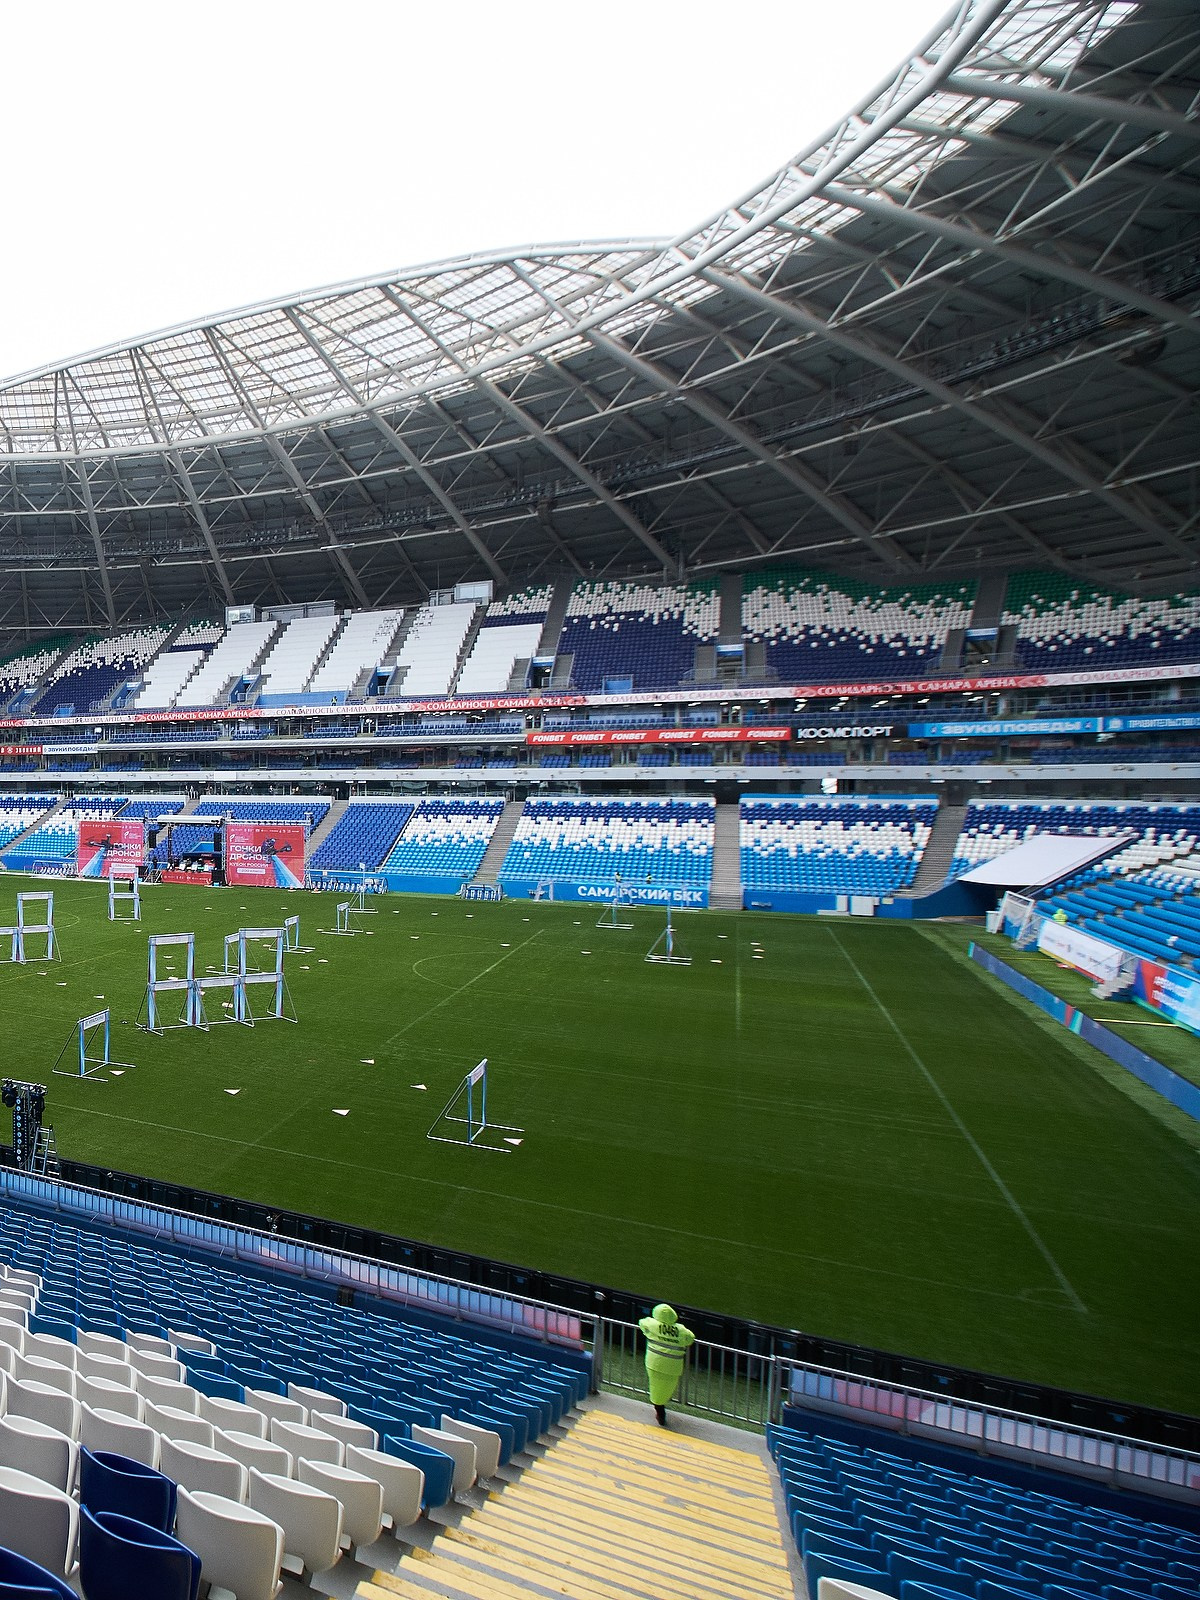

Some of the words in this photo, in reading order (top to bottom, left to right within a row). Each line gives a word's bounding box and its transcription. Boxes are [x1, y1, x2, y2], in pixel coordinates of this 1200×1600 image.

[917, 681, 973, 692] САМАРА
[974, 678, 1018, 688] АРЕНА
[336, 706, 368, 714] САМАРА
[369, 705, 395, 713] АРЕНА
[426, 701, 495, 710] СОЛИДАРНОСТЬ
[497, 699, 535, 708] САМАРА
[146, 713, 197, 721] СОЛИДАРНОСТЬ
[197, 711, 226, 720] САМАРА
[226, 710, 248, 718] АРЕНА
[941, 724, 999, 735] ЗВУКИ
[1003, 721, 1082, 733] ПОБЕДЫ
[658, 732, 696, 740] FONBET
[746, 730, 788, 738] FONBET
[107, 850, 141, 858] ДРОНОВ
[229, 845, 261, 853] ГОНКИ
[577, 886, 669, 900] САМАРСКИЙ
[673, 890, 703, 902] БКК
